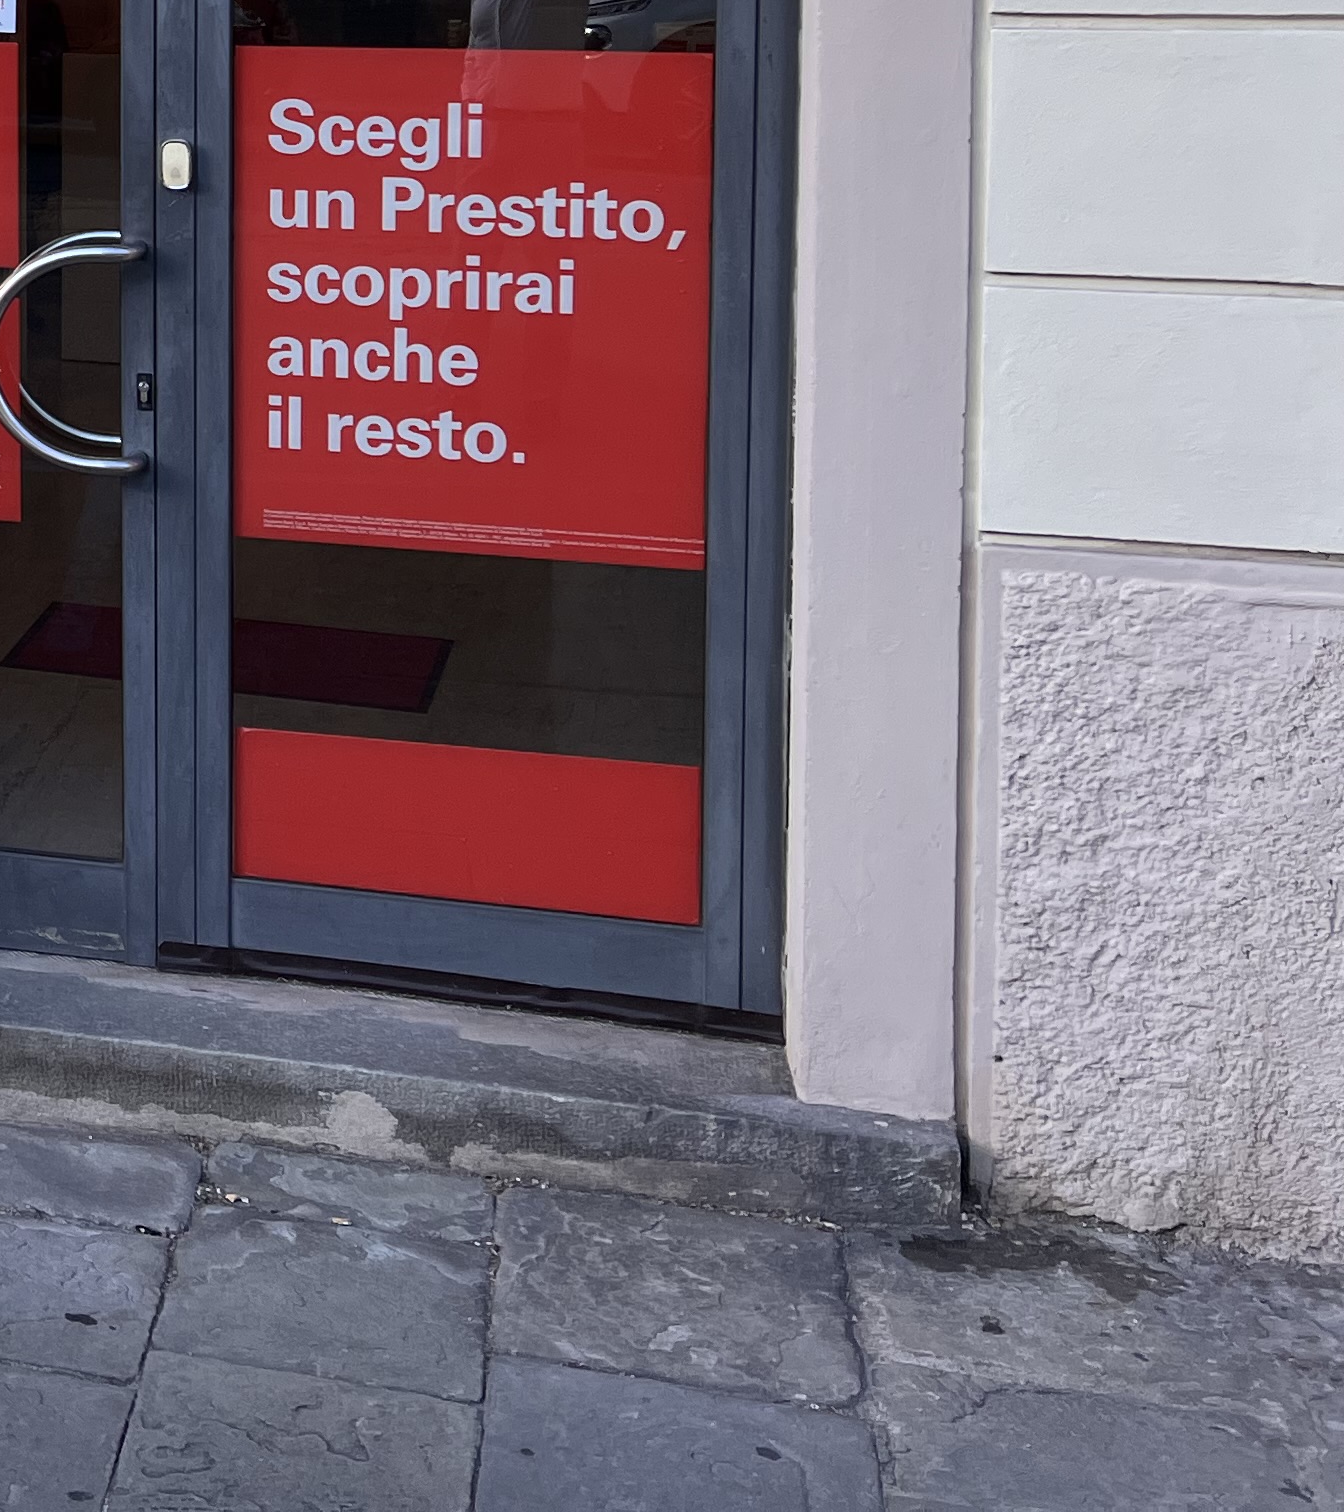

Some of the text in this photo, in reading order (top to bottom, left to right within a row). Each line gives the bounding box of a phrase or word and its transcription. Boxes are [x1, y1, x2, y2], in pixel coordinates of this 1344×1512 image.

[267, 98, 484, 172] Scegli
[268, 175, 687, 251] un Prestito,
[266, 254, 575, 321] scoprirai
[266, 327, 479, 387] anche
[267, 394, 526, 465] il resto.
